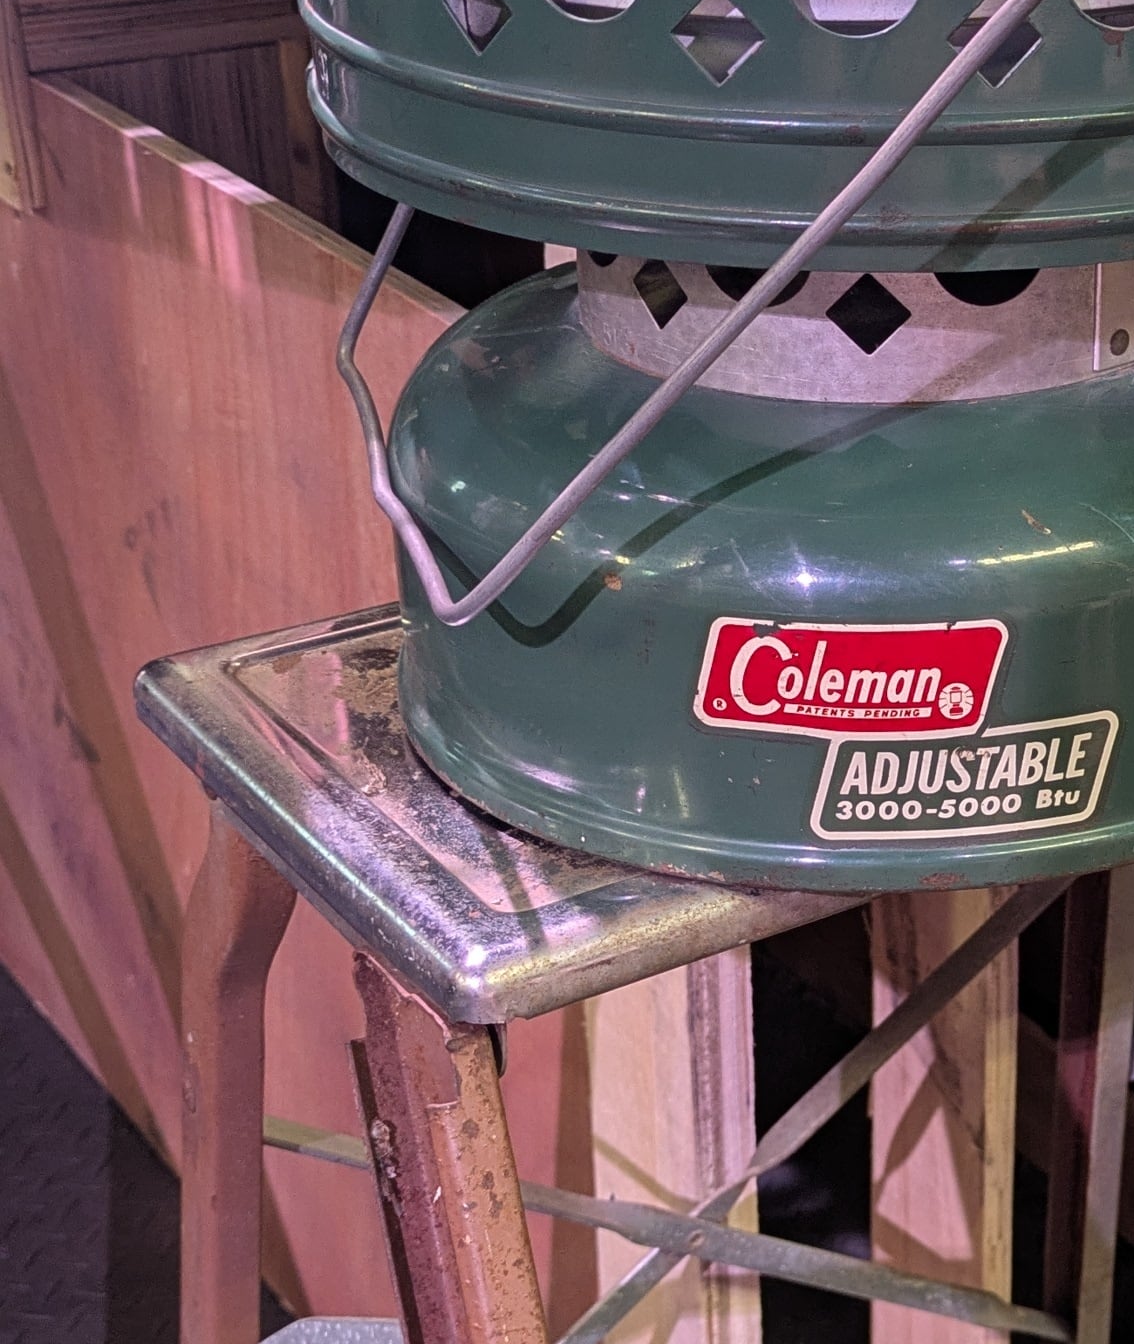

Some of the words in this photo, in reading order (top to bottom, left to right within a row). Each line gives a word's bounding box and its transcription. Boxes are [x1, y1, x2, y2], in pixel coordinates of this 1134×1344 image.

[729, 635, 942, 716] Coleman
[796, 705, 855, 718] PATENTS
[863, 707, 921, 718] PENDING
[839, 732, 1094, 795] ADJUSTABLE
[835, 793, 1022, 821] 3000-5000
[1035, 787, 1081, 810] Btu
